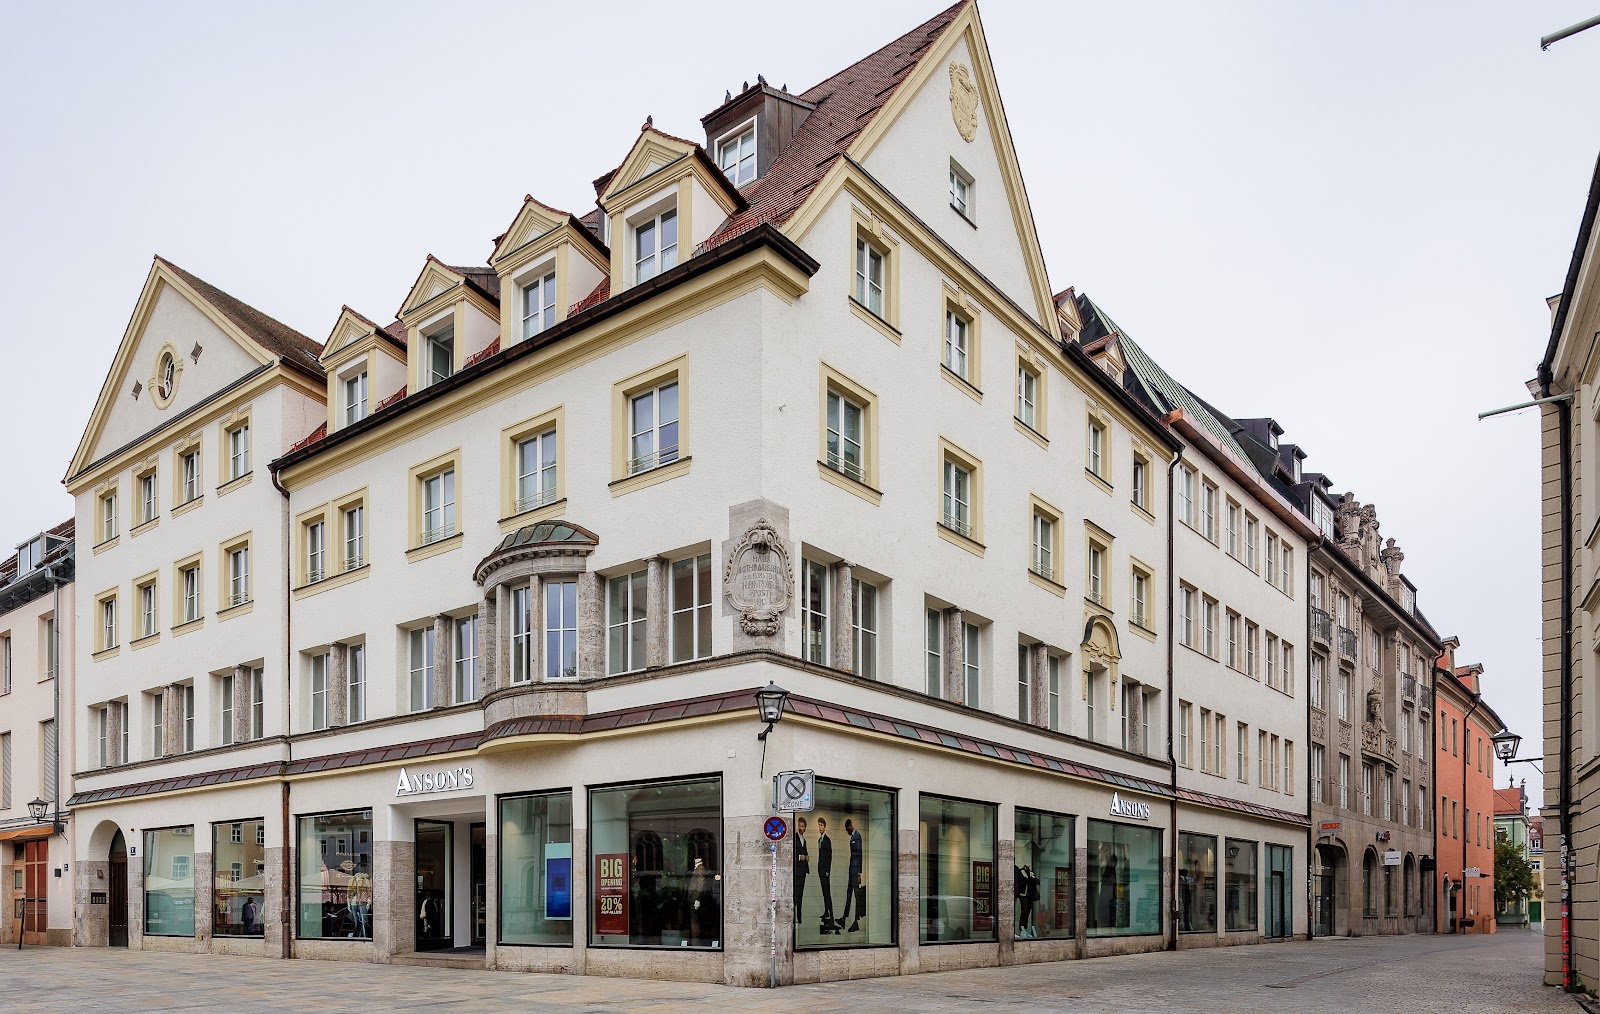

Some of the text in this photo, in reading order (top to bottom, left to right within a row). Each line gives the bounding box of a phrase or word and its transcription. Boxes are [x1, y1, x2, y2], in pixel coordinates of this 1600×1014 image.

[395, 767, 474, 797] ANSON'S
[786, 800, 803, 808] ZONE
[1110, 791, 1151, 818] ANSON'S
[601, 858, 623, 878] BIG
[977, 865, 990, 883] BIG
[601, 878, 623, 887] OPENING
[601, 898, 623, 911] 20%
